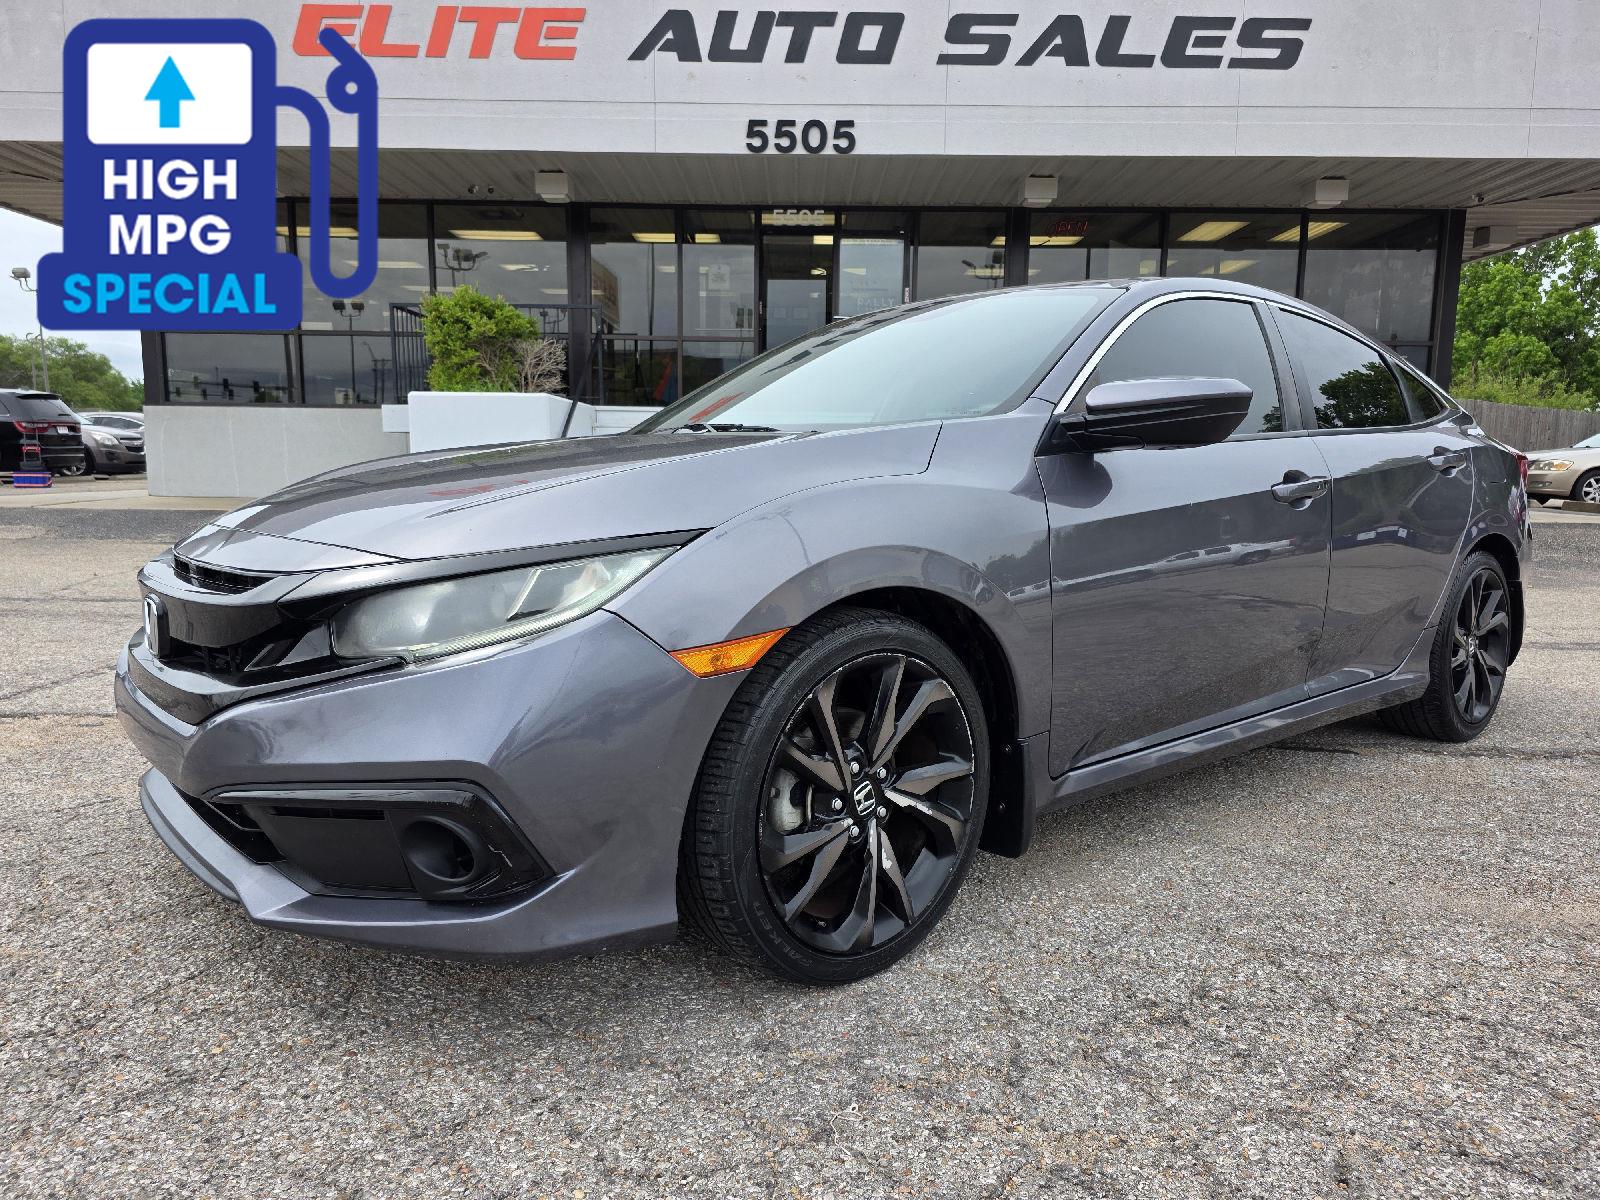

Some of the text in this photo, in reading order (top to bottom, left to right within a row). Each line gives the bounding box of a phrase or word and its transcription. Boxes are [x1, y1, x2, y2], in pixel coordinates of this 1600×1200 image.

[292, 4, 1313, 70] ELITE AUTO SALES
[746, 119, 856, 154] 5505
[773, 209, 825, 227] 5505
